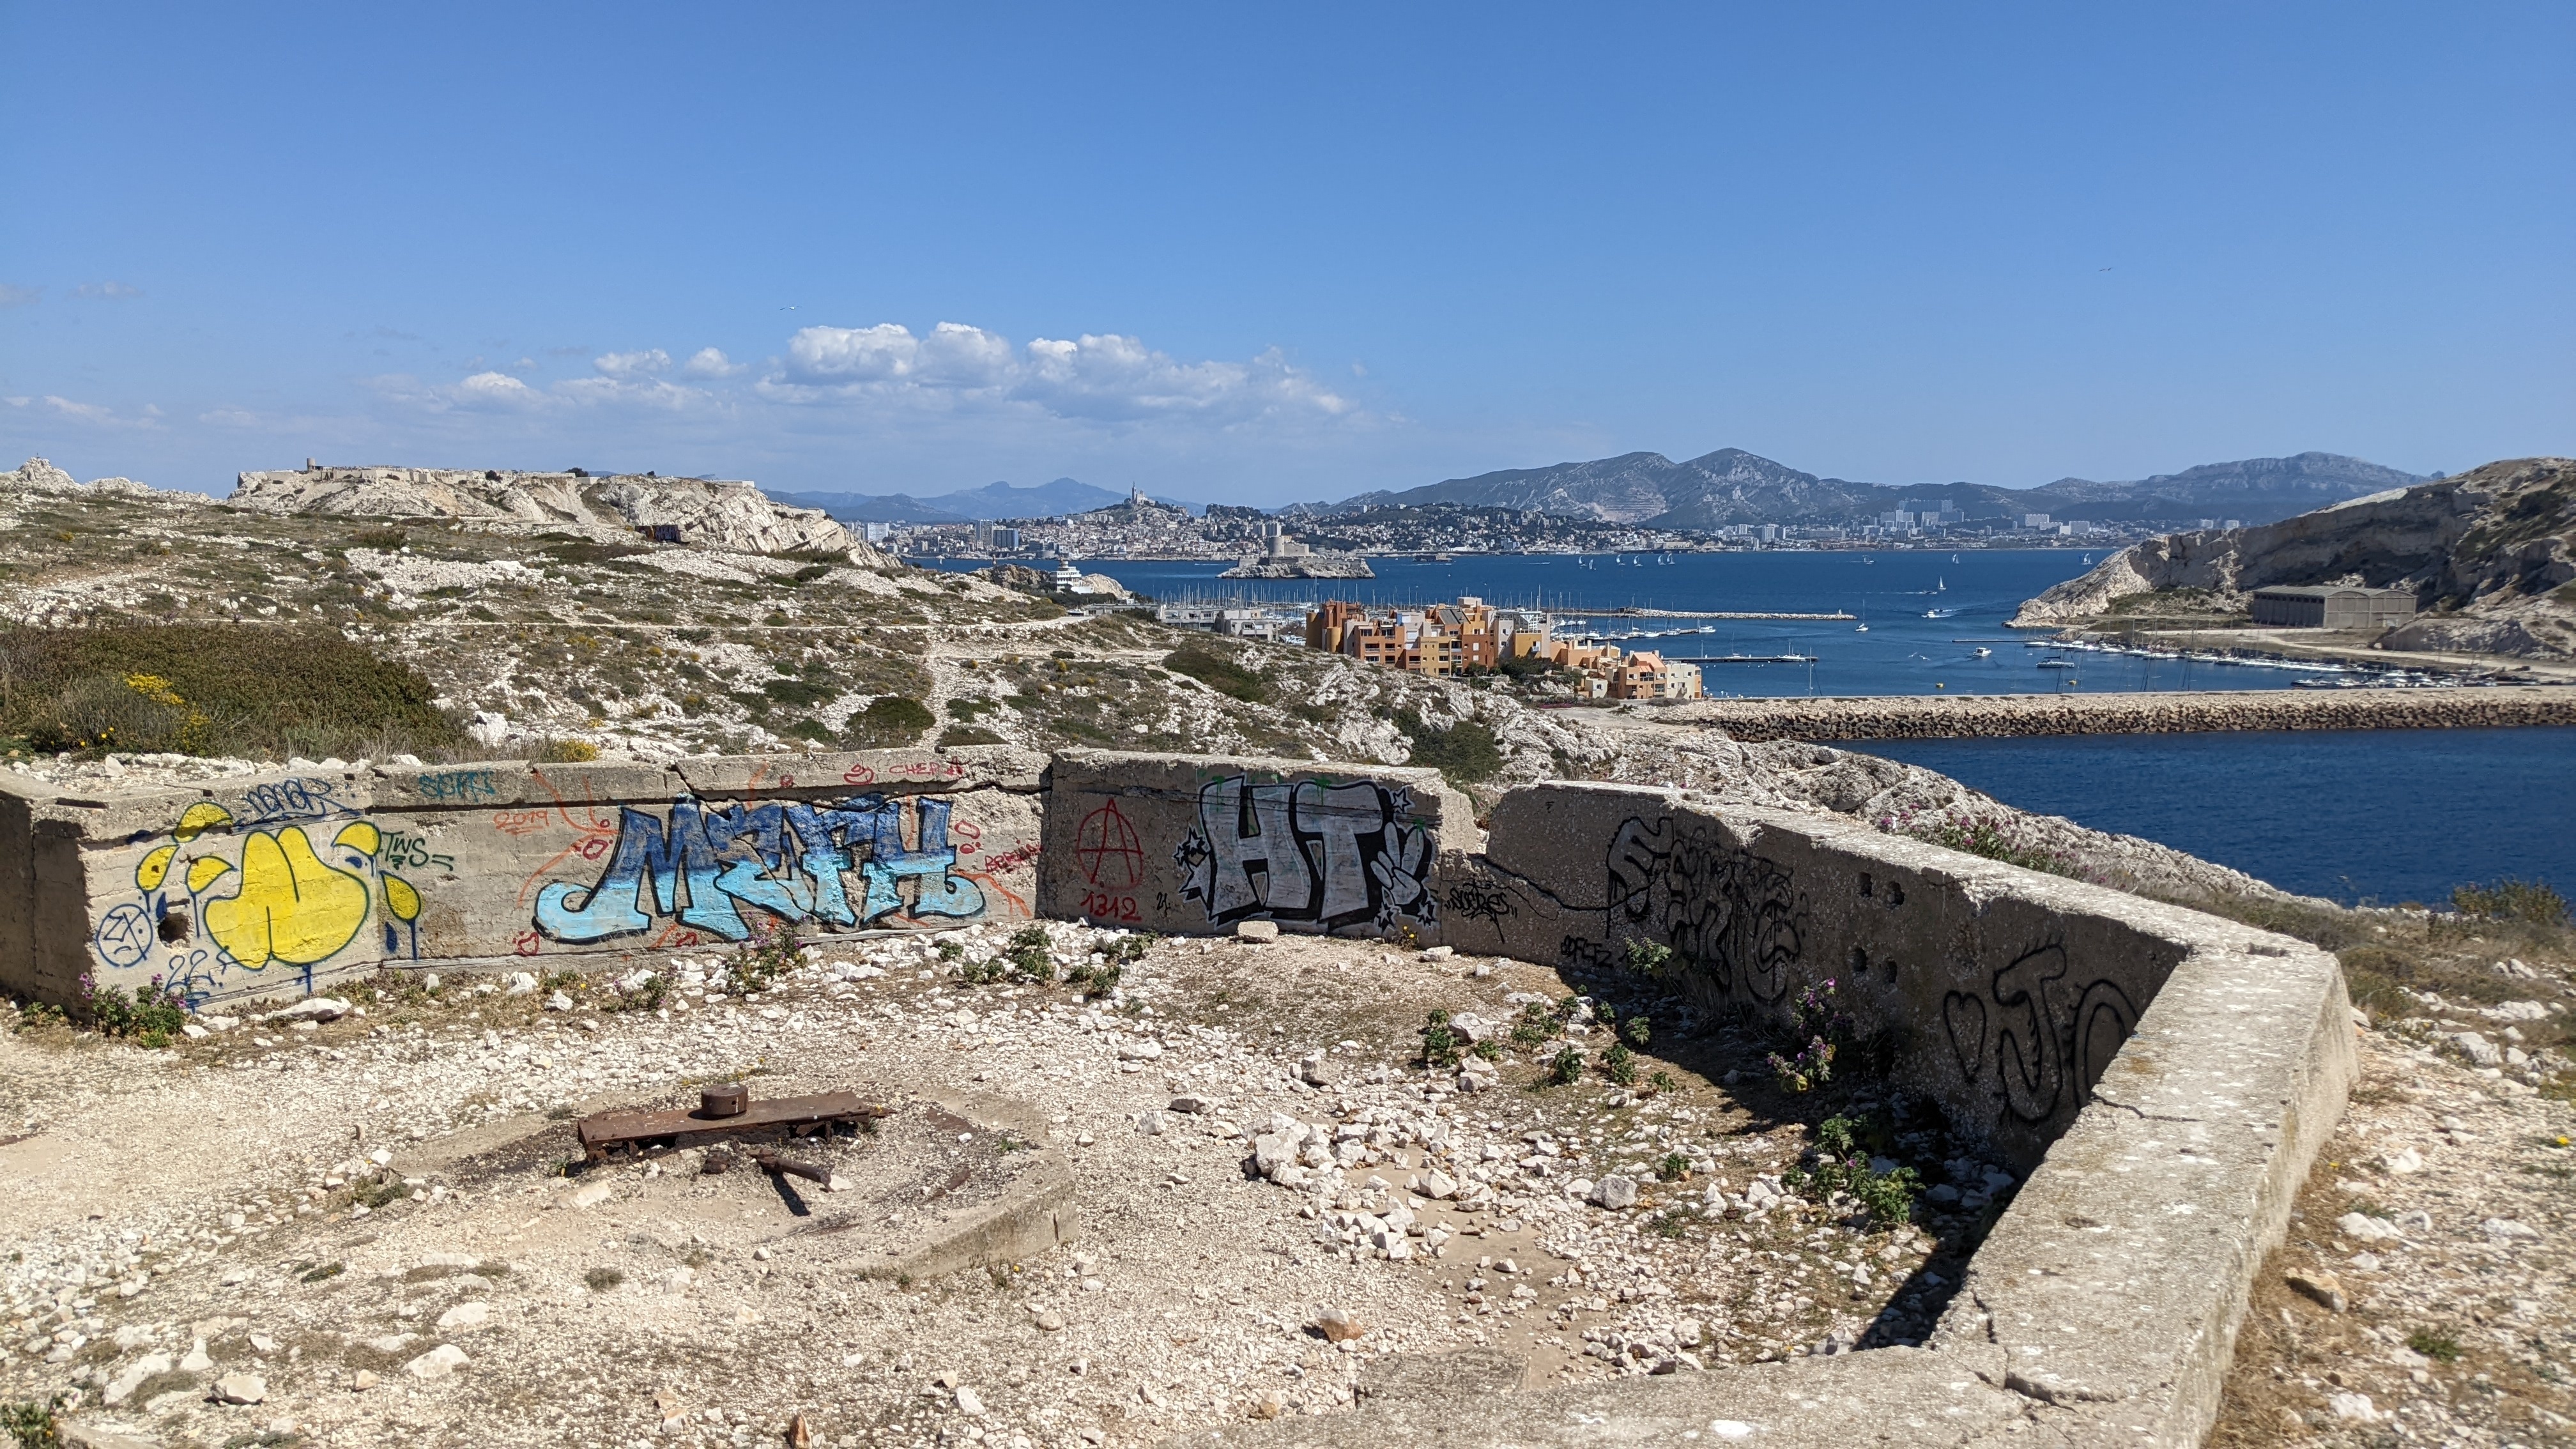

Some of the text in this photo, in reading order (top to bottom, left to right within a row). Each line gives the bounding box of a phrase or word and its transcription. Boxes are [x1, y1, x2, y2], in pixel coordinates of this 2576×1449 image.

[493, 809, 550, 830] 2019
[382, 831, 429, 867] TWS
[1080, 891, 1142, 921] 1312
